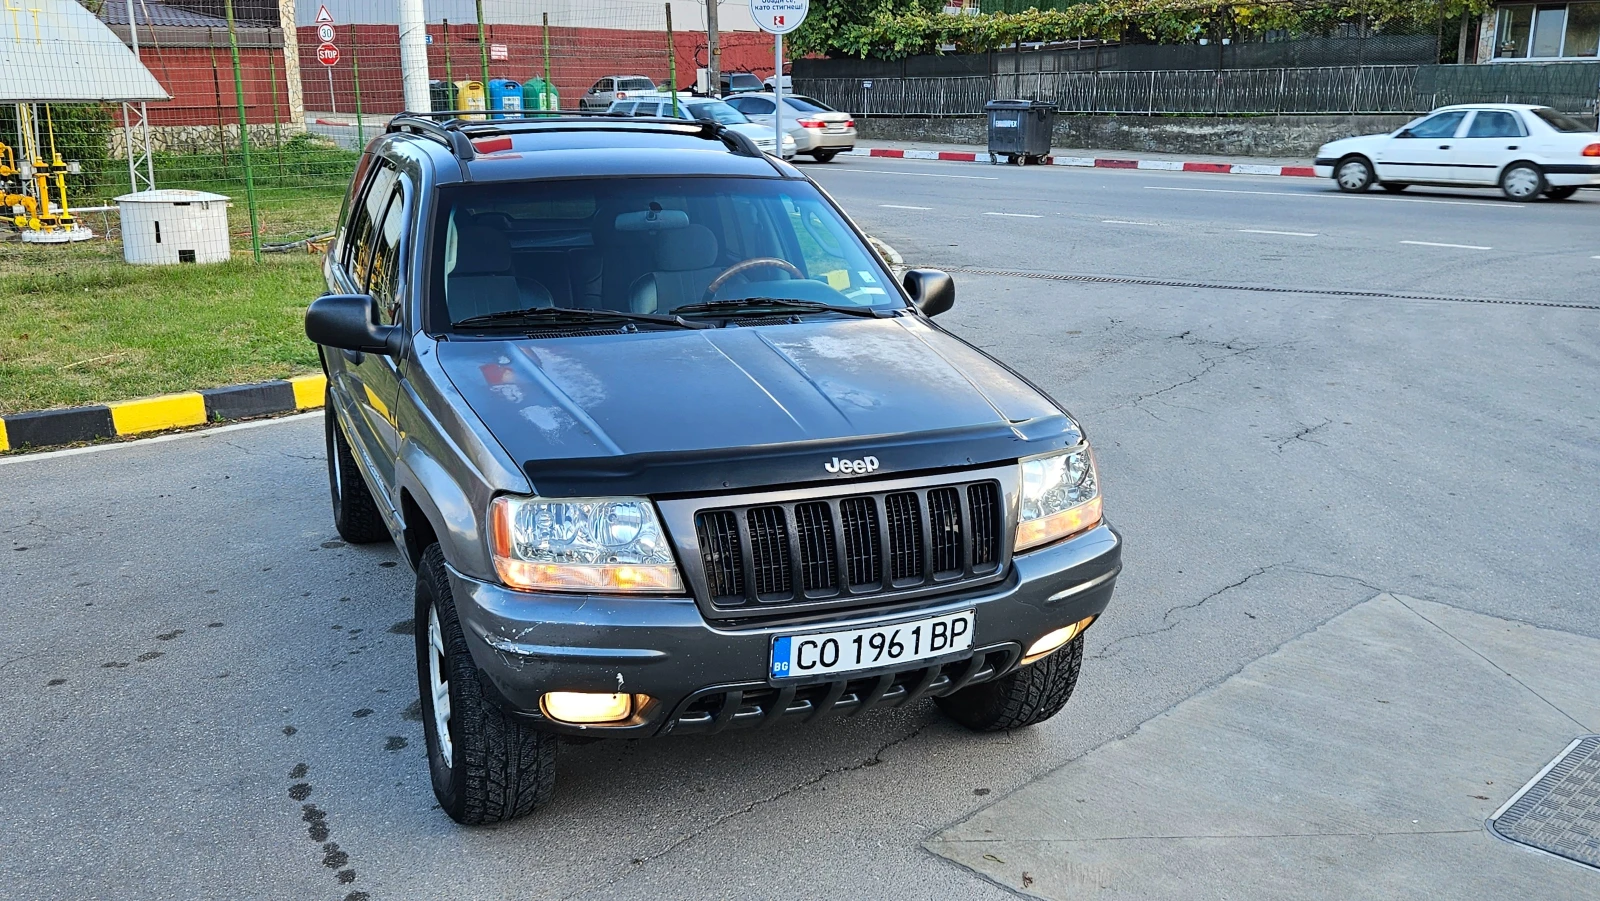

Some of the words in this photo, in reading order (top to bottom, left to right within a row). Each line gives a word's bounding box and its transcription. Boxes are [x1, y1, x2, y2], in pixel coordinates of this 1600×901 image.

[321, 28, 331, 37] 30
[320, 50, 337, 58] STOP
[824, 455, 880, 473] Jeep
[796, 638, 840, 670] CO
[852, 625, 921, 664] 1961
[929, 617, 968, 652] BP
[773, 662, 788, 672] BG
